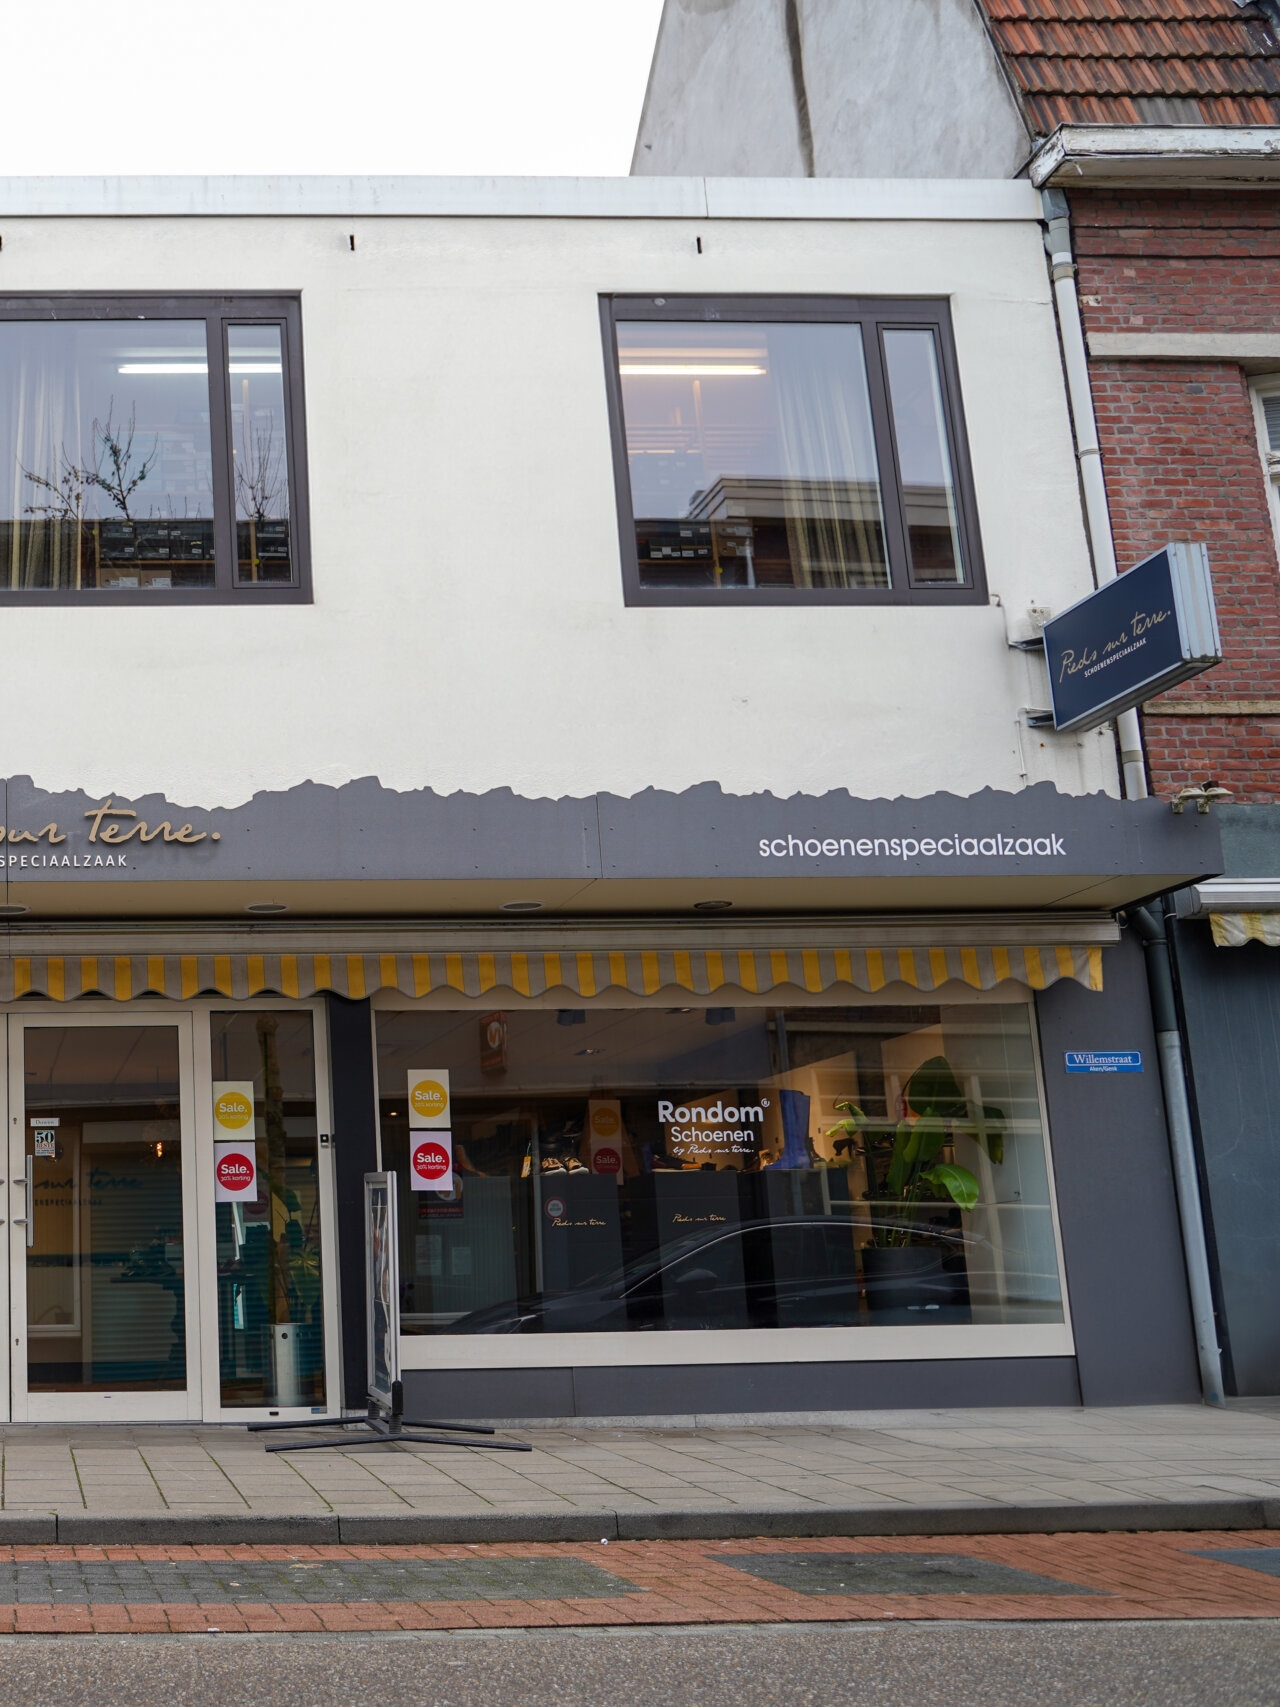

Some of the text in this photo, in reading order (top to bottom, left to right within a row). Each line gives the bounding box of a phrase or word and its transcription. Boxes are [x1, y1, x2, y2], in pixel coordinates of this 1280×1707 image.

[1059, 648, 1097, 683] Pieds
[1102, 632, 1128, 654] sur
[1084, 637, 1147, 678] SCHOENENSPECIAALZAAK
[759, 834, 1066, 861] schoenenspeciaalzaak
[1073, 1054, 1132, 1064] Willemstraat
[36, 1132, 54, 1144] 50
[671, 1126, 754, 1142] Schoenen
[687, 1144, 712, 1154] Pieds
[417, 1153, 446, 1162] Sale.
[221, 1164, 250, 1174] Sale.
